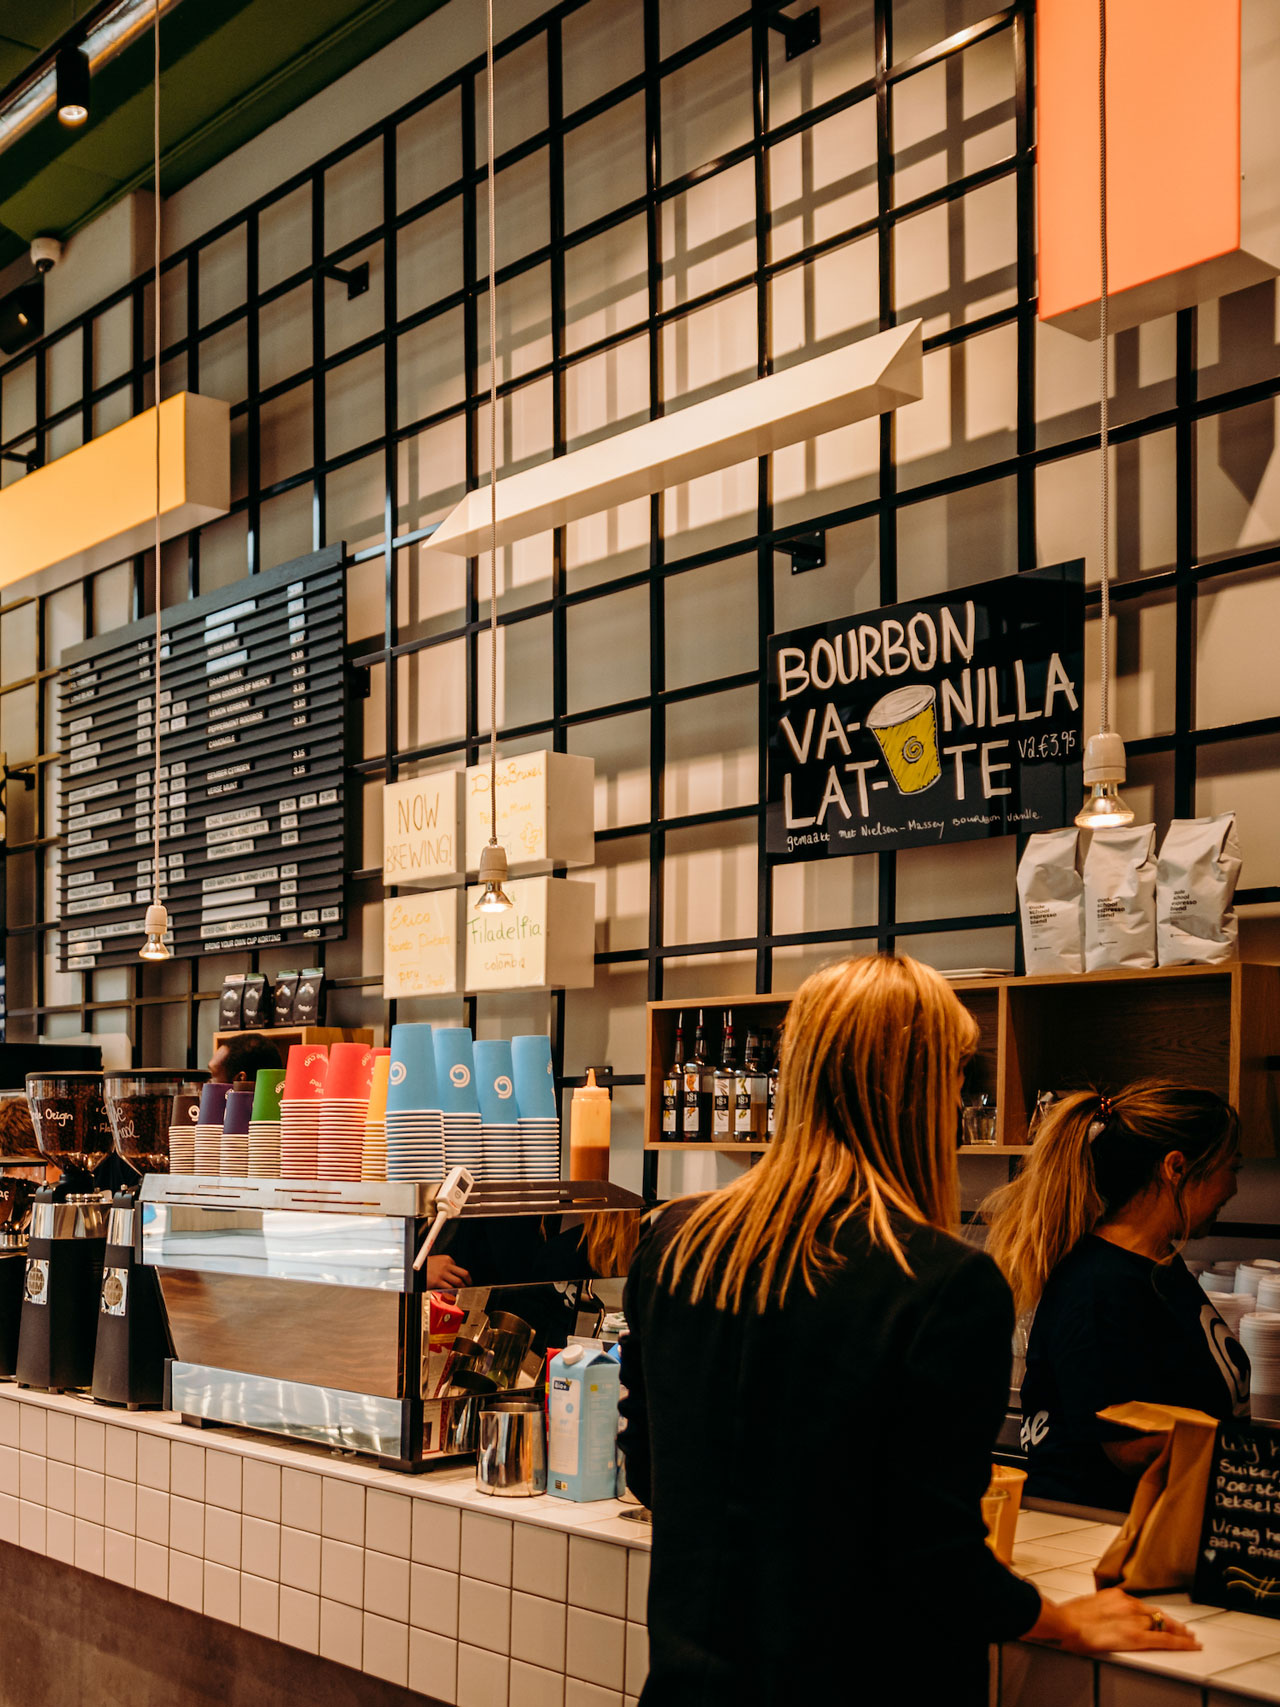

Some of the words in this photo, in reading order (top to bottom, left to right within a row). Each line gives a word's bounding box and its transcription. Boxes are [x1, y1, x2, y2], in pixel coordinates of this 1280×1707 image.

[778, 600, 976, 700] BOURBON
[940, 653, 1079, 732] NILLA
[943, 739, 1013, 800] TE
[398, 791, 440, 834] NOW
[386, 833, 453, 874] BREWING!
[258, 870, 275, 881] LATTE
[466, 916, 542, 946] Filadelfia
[45, 1108, 74, 1127] Origin
[1209, 1535, 1241, 1552] aan
[1212, 1518, 1260, 1545] Vraag
